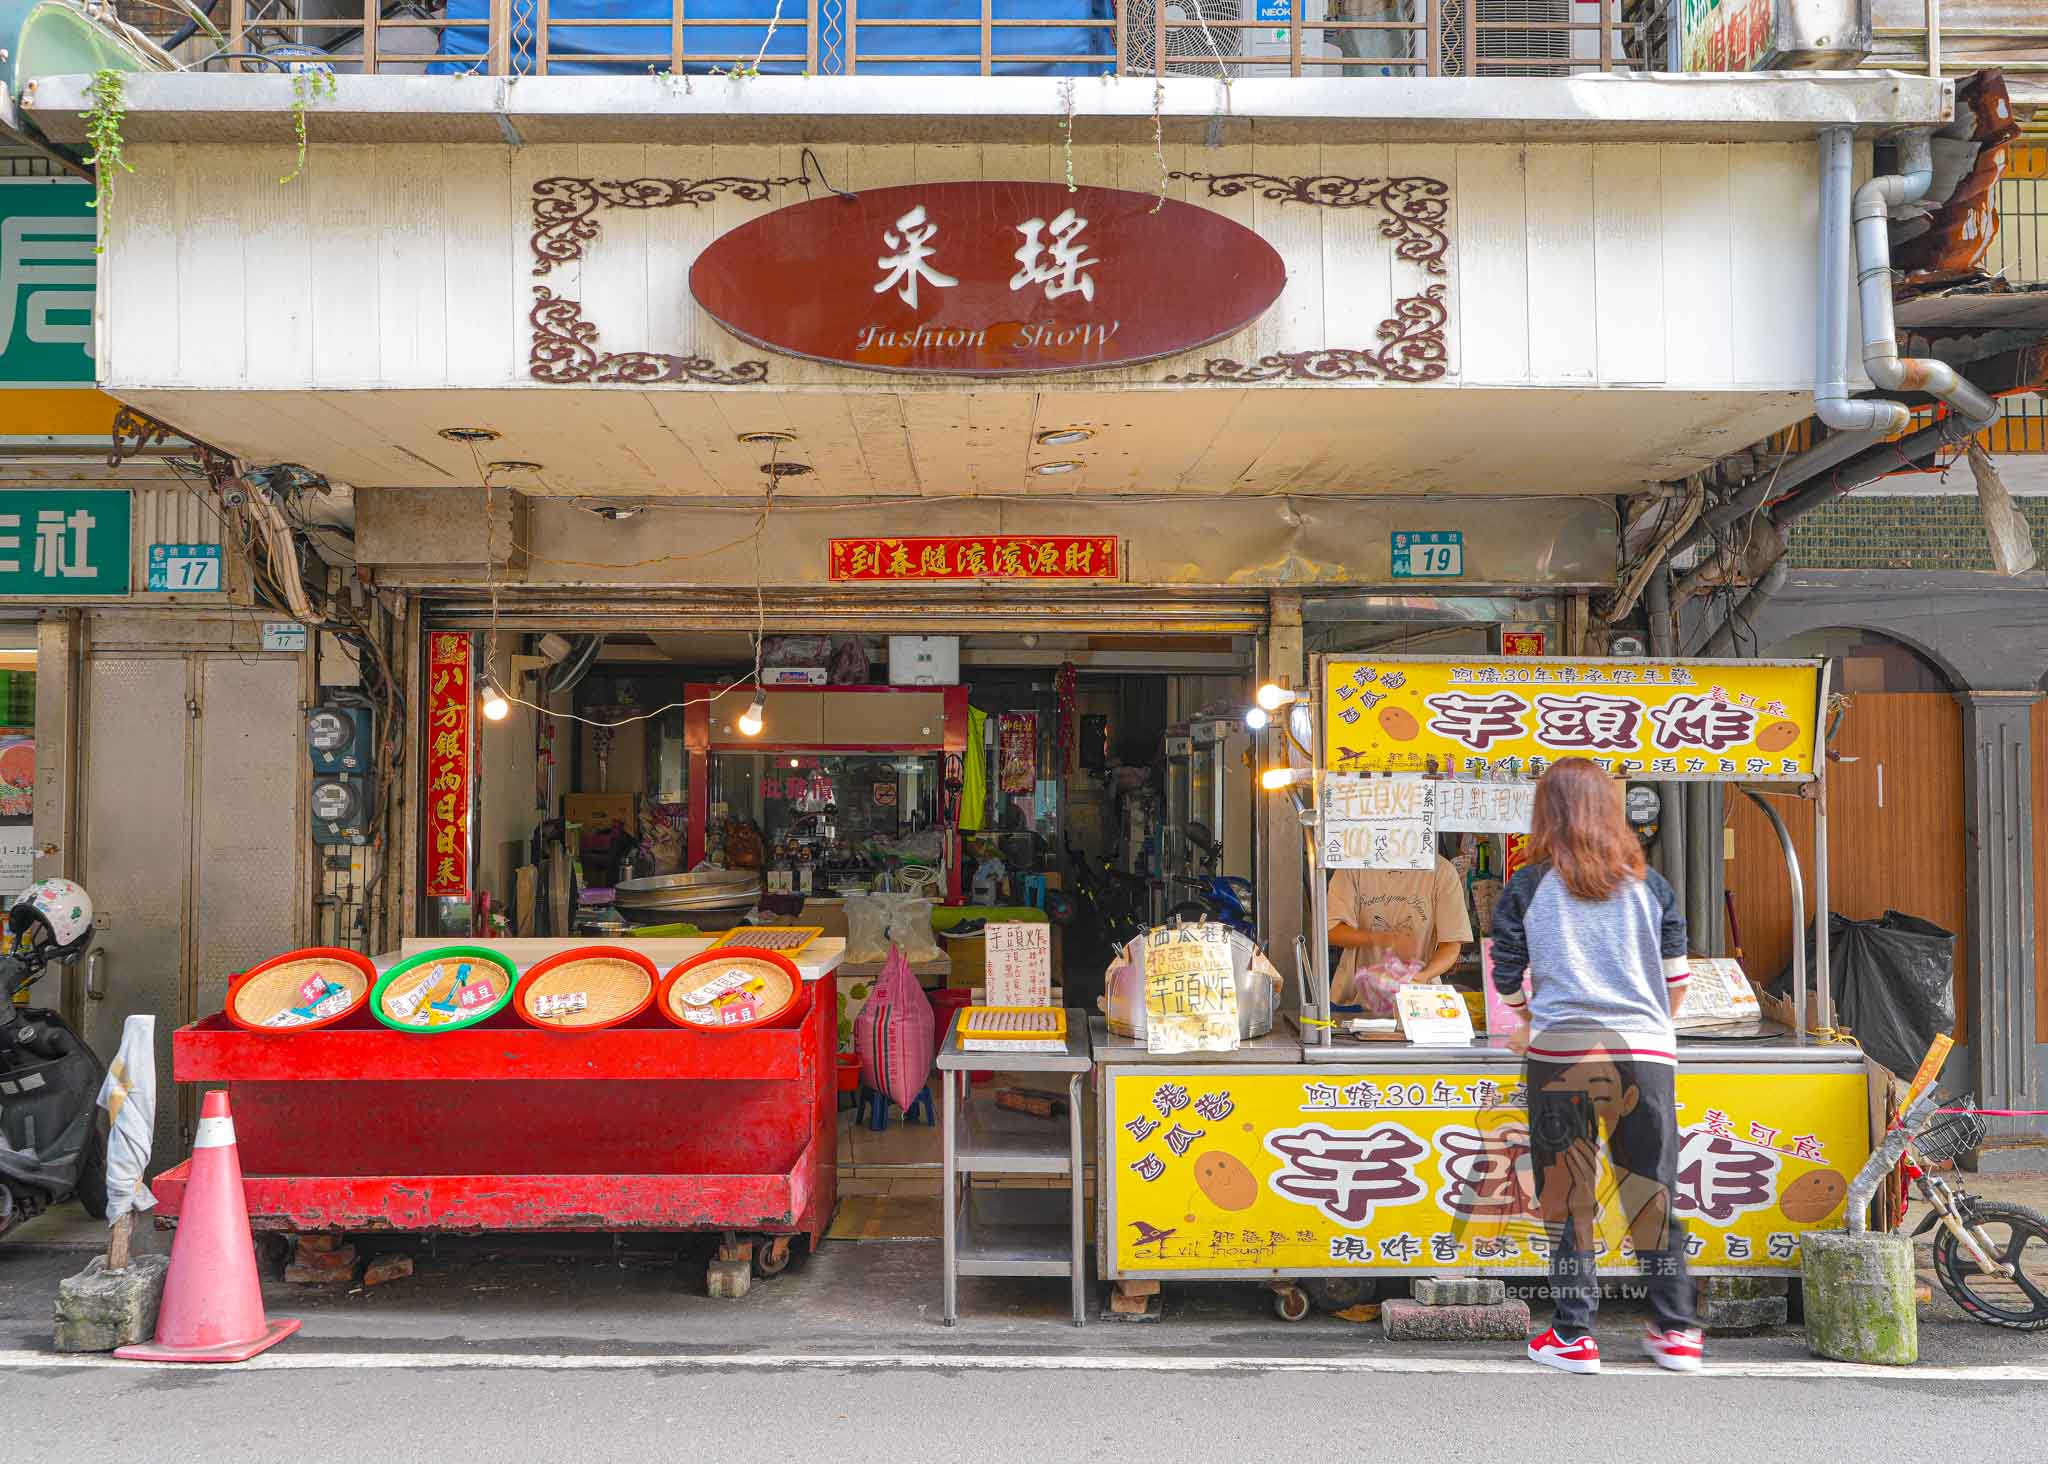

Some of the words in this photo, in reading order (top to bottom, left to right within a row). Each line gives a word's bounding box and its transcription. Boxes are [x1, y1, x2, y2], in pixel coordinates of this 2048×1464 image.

[857, 321, 986, 351] Fashion
[180, 561, 209, 586] 17
[1424, 547, 1451, 571] 19
[1426, 691, 1757, 753] 芋頭炸
[1152, 973, 1233, 1016] 芋頭炸
[724, 1007, 755, 1025] 紅豆
[1704, 1109, 1826, 1160] 素可食
